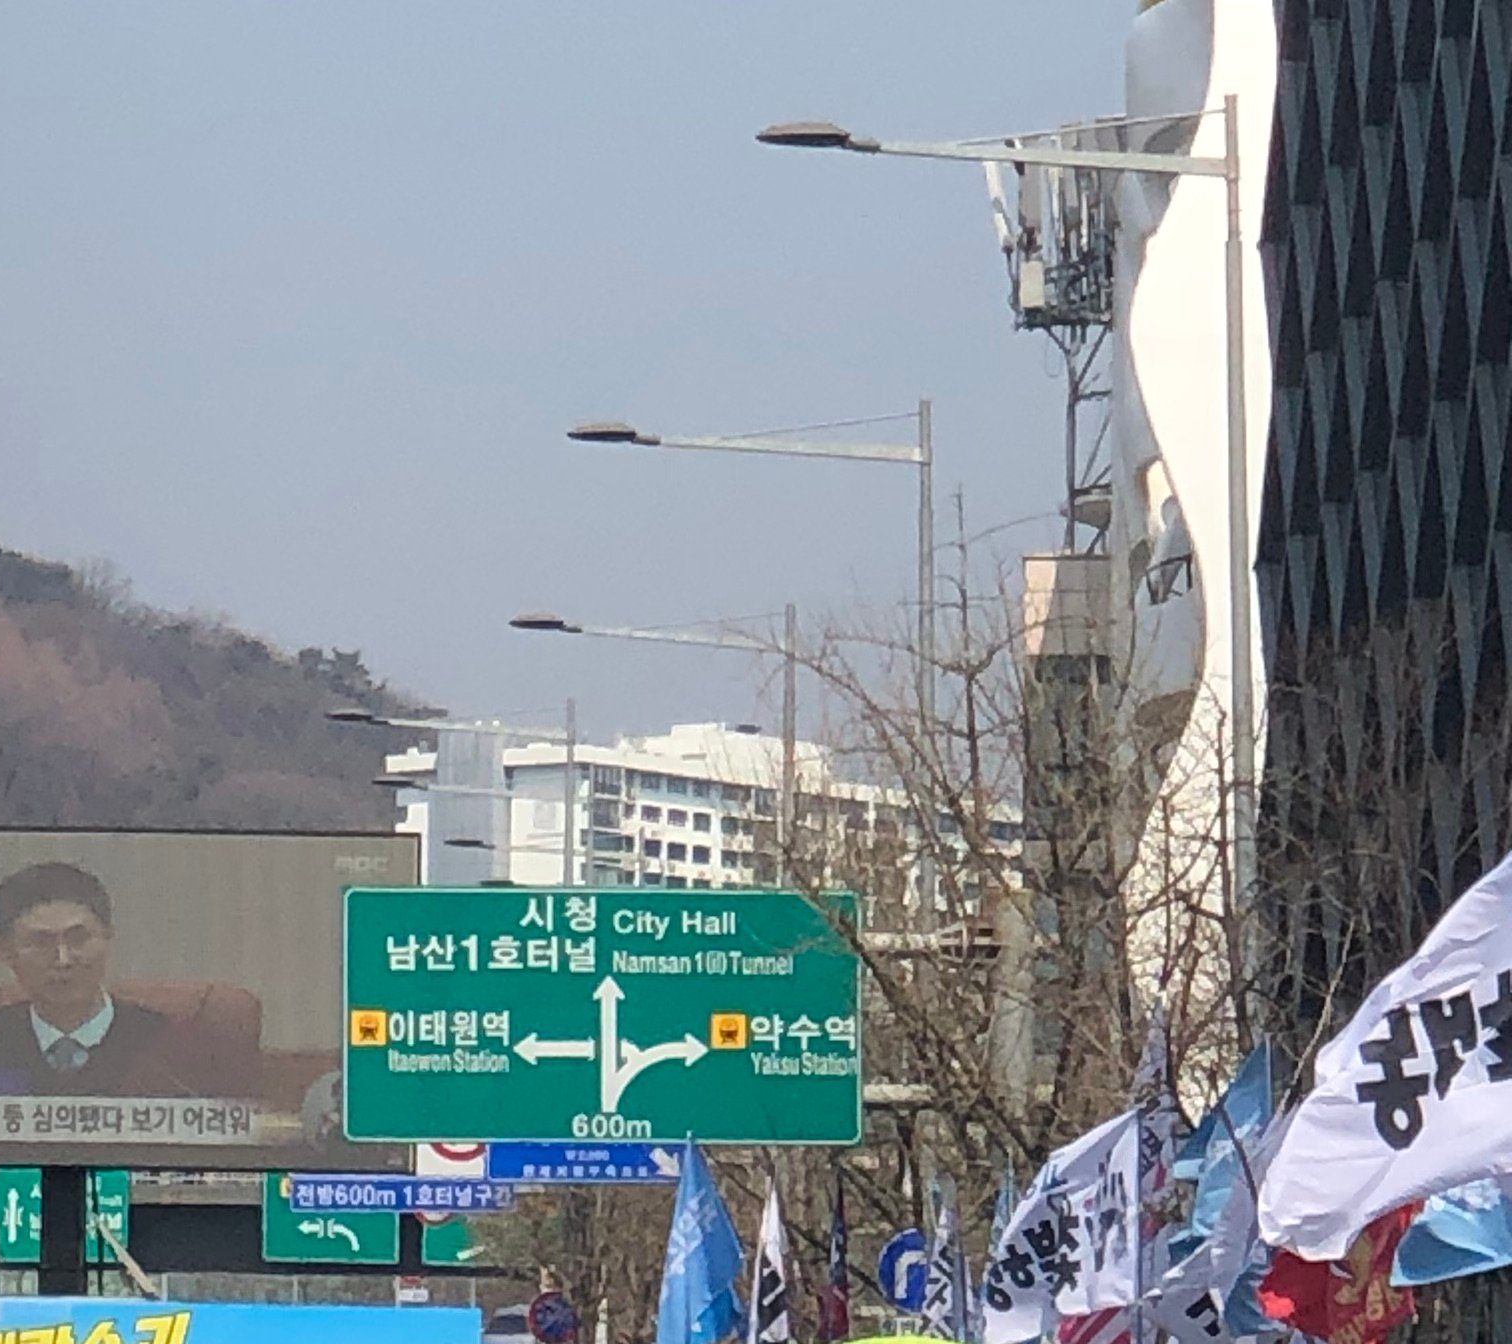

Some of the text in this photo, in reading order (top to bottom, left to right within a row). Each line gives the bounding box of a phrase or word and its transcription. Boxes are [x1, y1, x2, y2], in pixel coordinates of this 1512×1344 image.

[612, 909, 737, 941] City Hall
[612, 951, 692, 974] Namsan
[728, 951, 794, 975] Tunnel
[388, 1010, 510, 1046] 이태원역
[751, 1014, 856, 1050] 약수역
[452, 1048, 510, 1073] Station
[751, 1053, 858, 1076] Yaksu Station
[3, 1104, 24, 1133] 등
[131, 1106, 175, 1133] 보기
[571, 1114, 652, 1138] 600m
